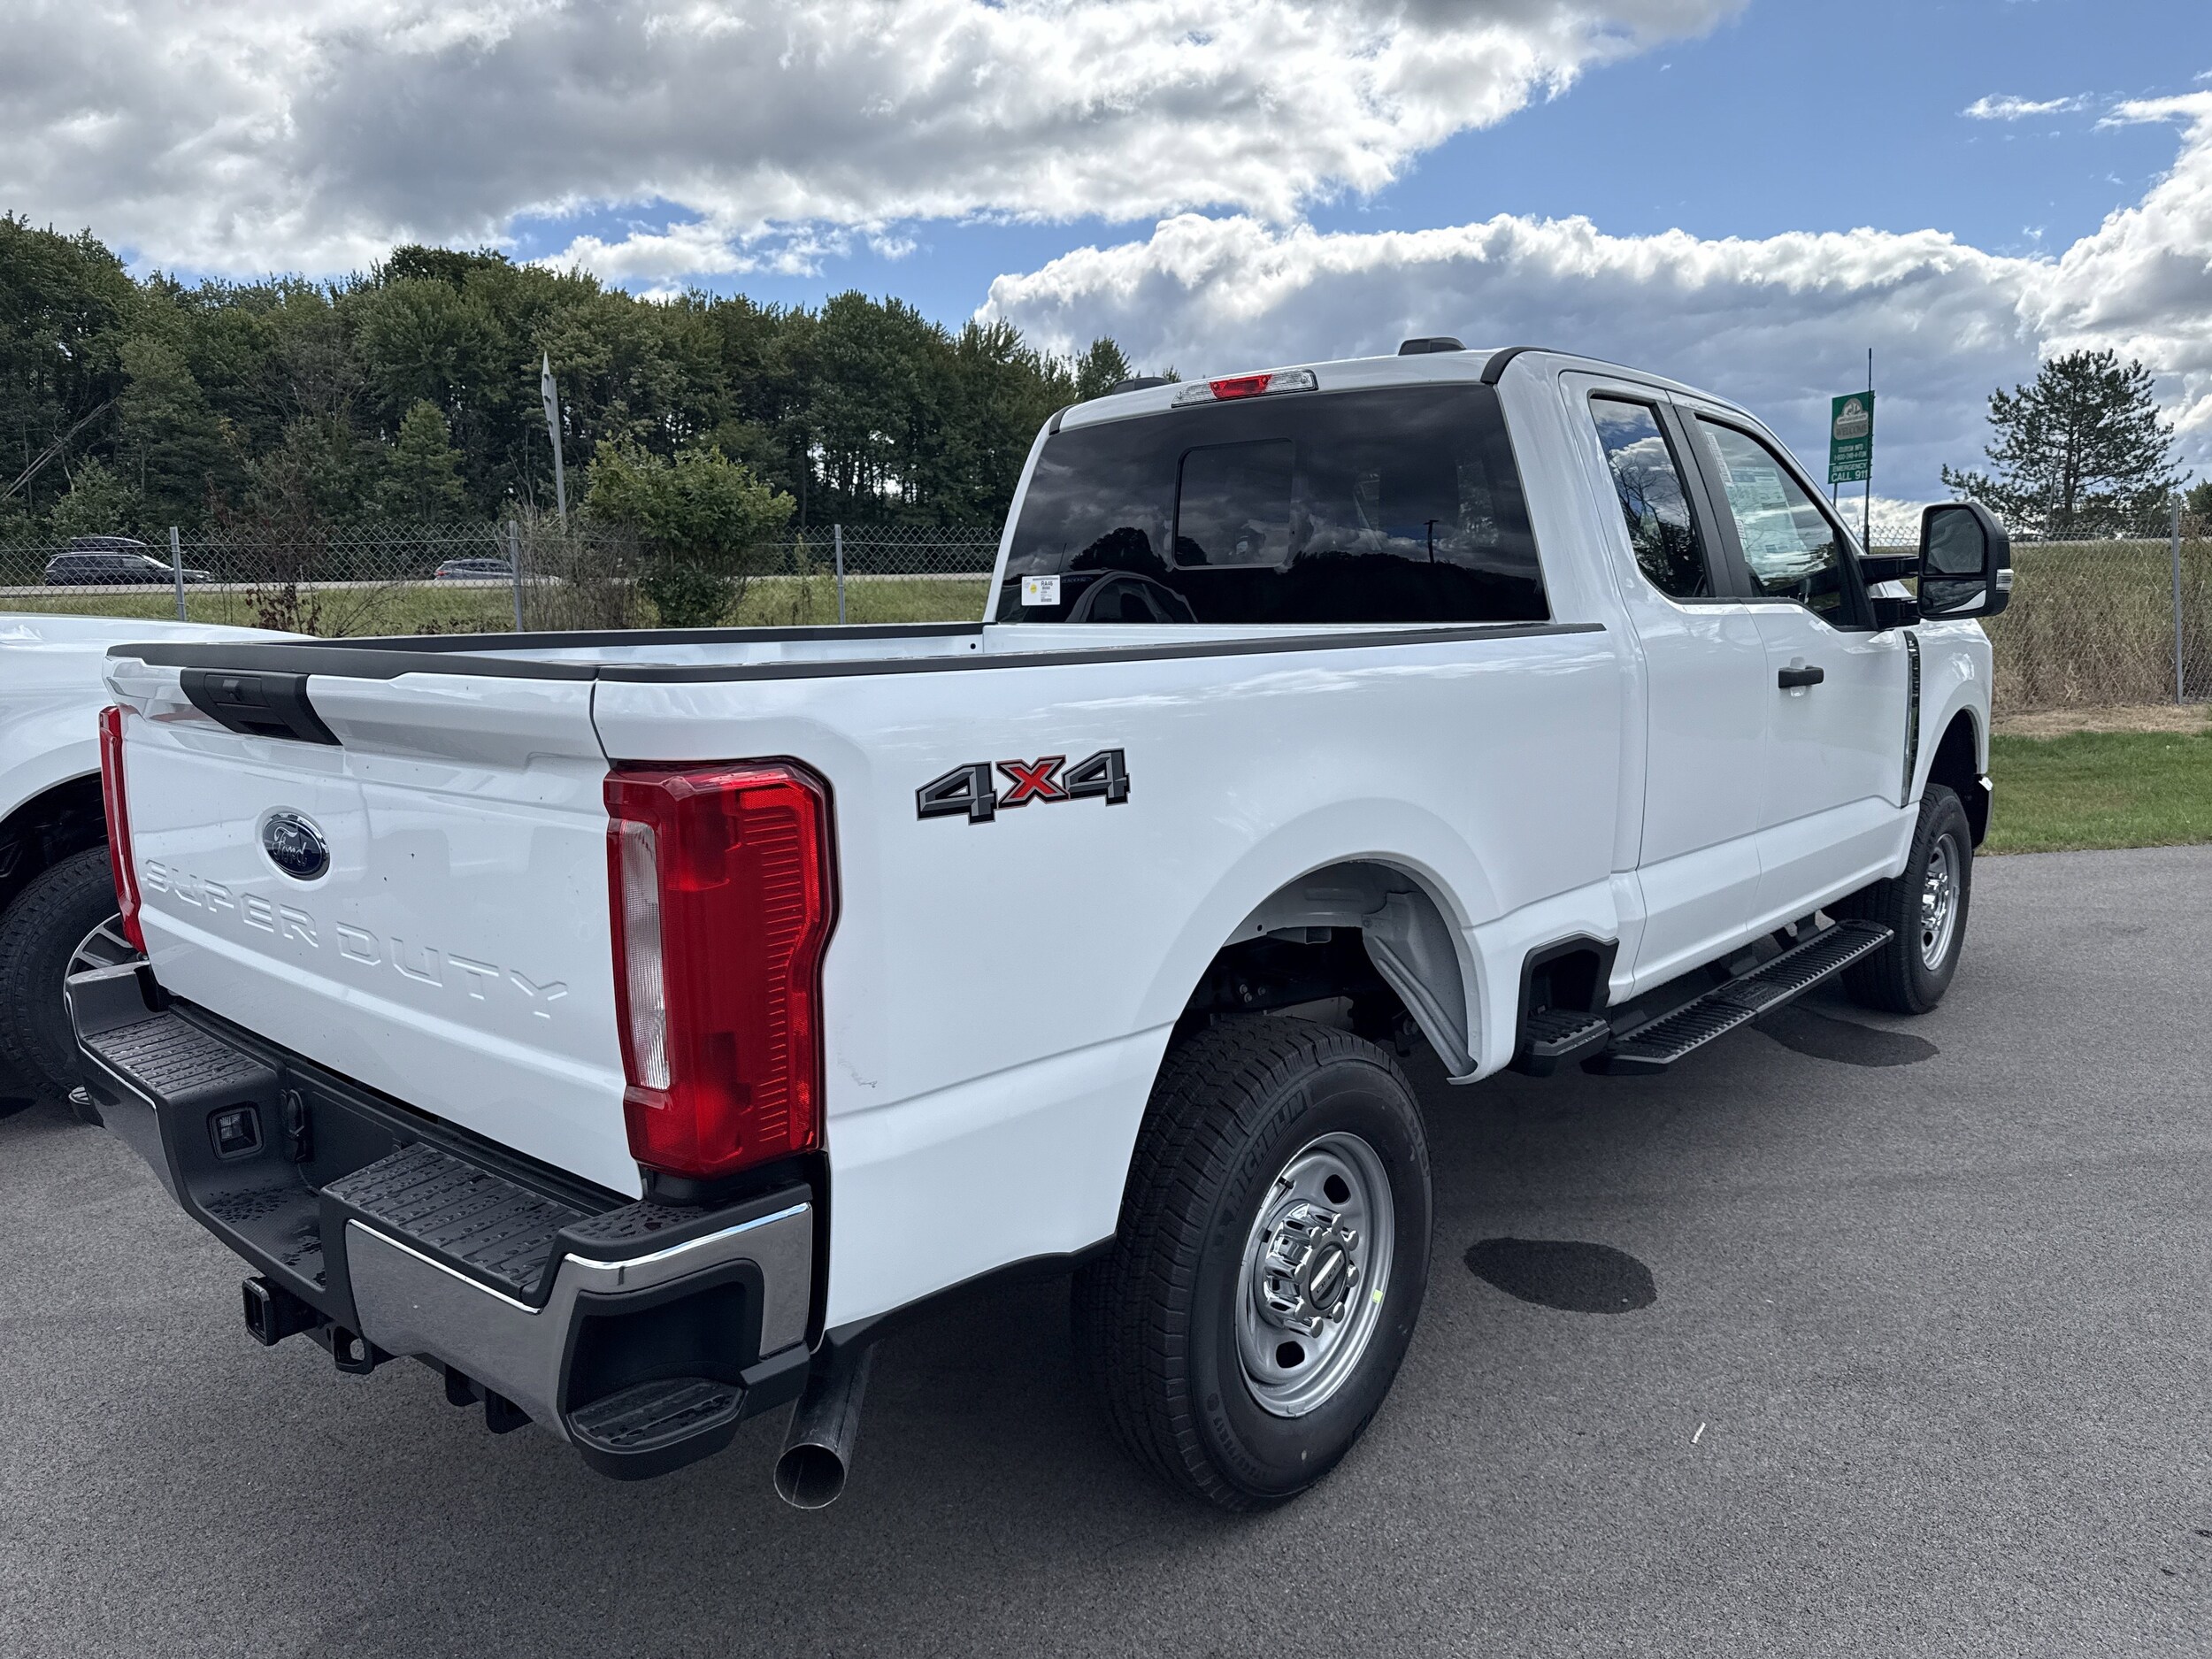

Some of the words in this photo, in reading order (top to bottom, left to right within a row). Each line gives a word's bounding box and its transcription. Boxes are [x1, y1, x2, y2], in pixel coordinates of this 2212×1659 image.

[1831, 472, 1852, 482] CALL
[1855, 470, 1868, 480] 911
[1832, 463, 1867, 472] EMERGENCY
[270, 824, 308, 868] Ford
[143, 858, 319, 949] SUPER
[335, 920, 569, 1020] DUTY
[1225, 1089, 1308, 1215] MICHELIN
